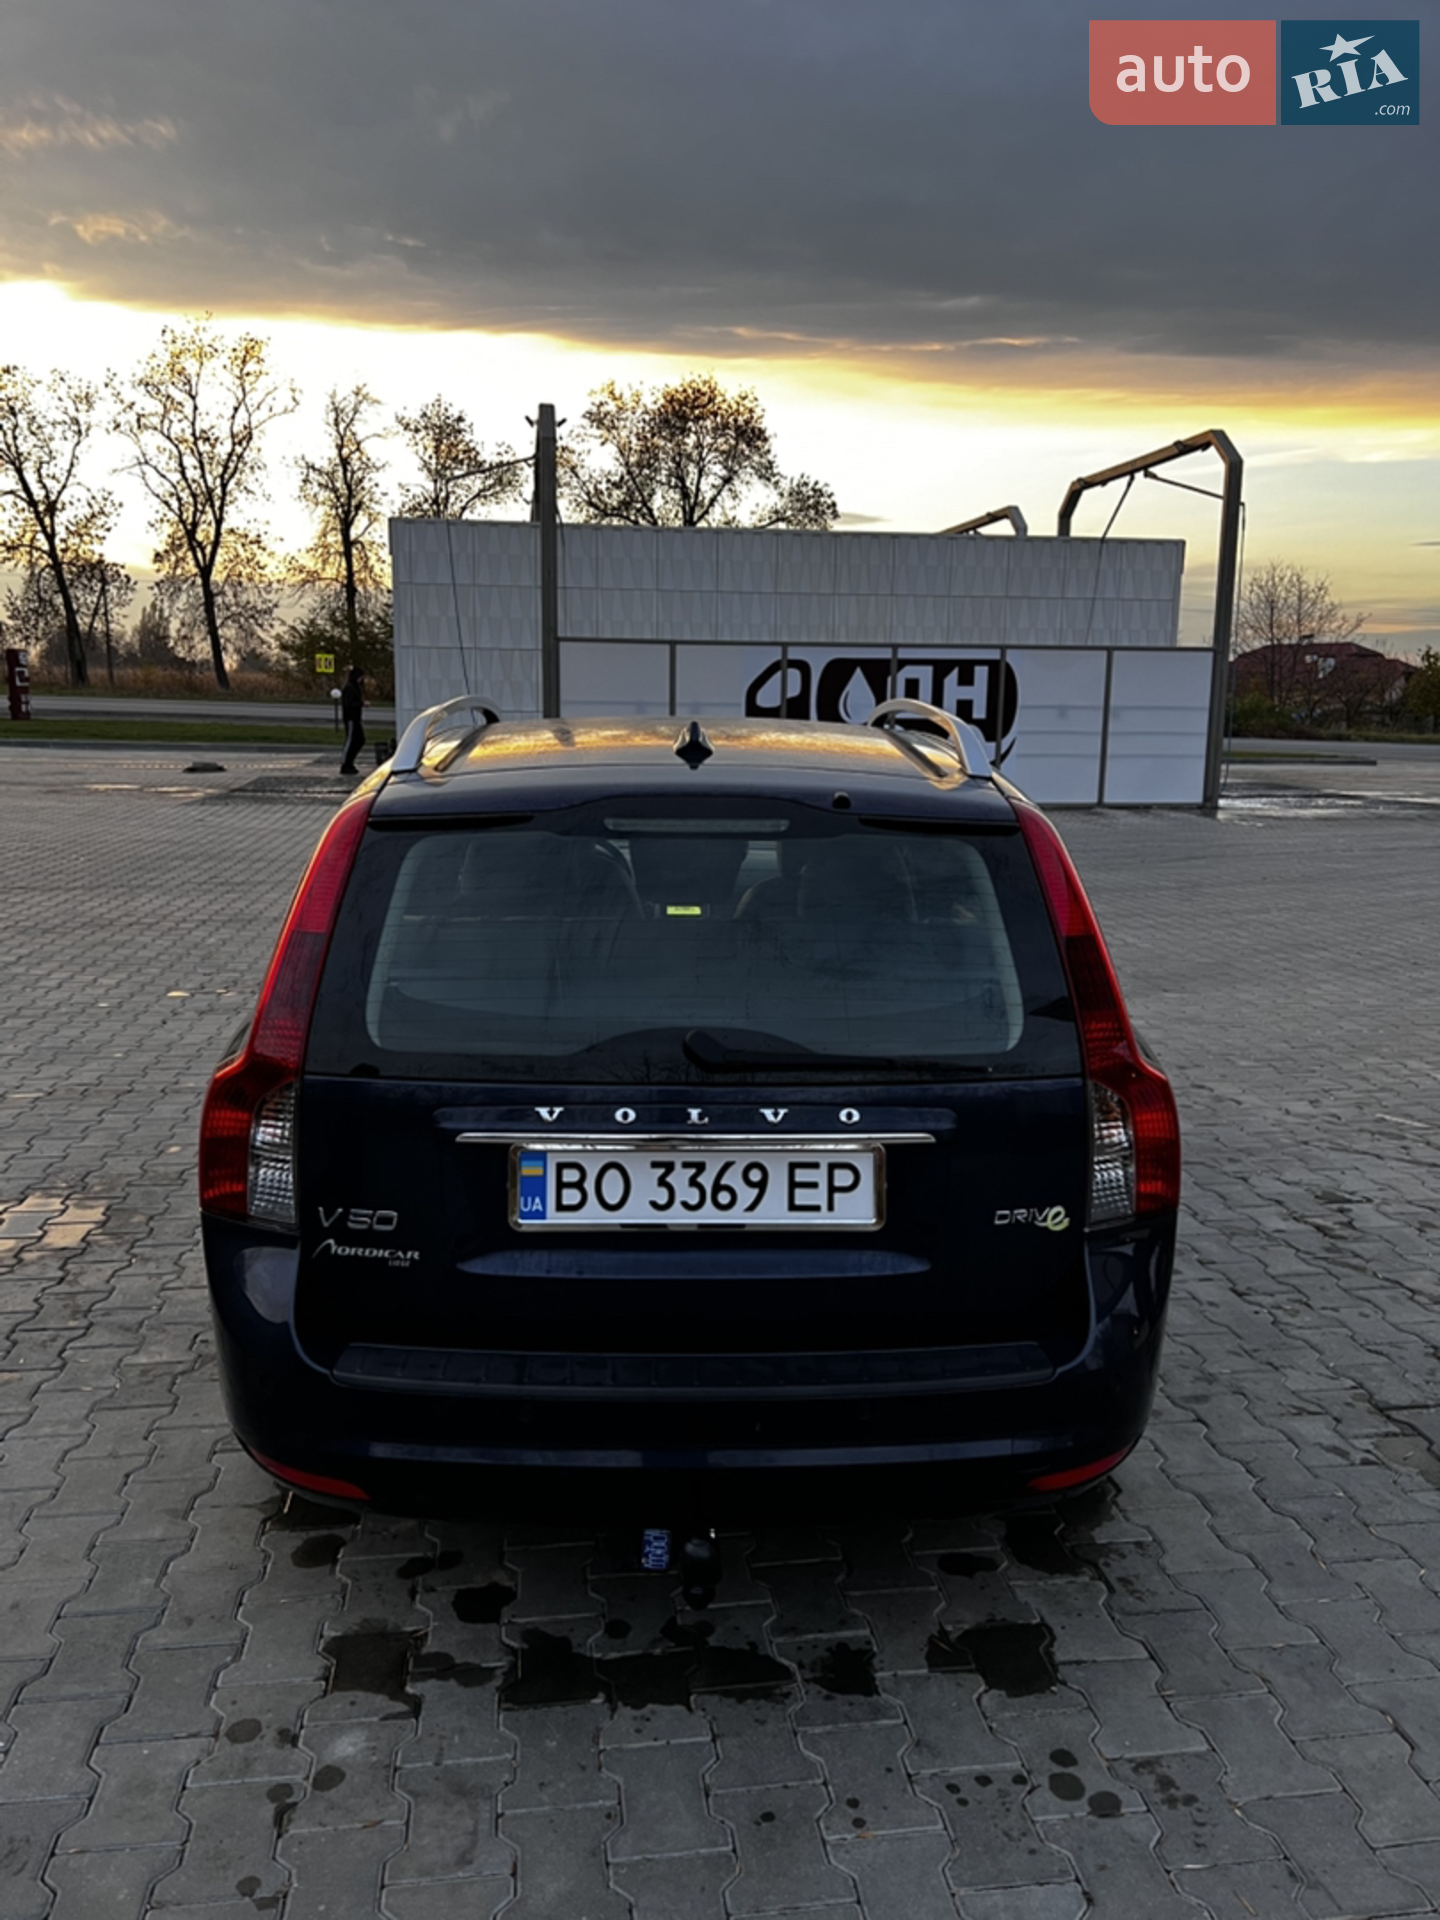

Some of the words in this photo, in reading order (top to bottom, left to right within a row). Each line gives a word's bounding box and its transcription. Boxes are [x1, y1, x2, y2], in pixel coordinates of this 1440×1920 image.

[535, 1107, 861, 1124] VOLVO
[554, 1161, 631, 1213] BO
[648, 1161, 769, 1213] 3369
[787, 1161, 861, 1213] EP
[520, 1197, 543, 1212] UA
[317, 1206, 398, 1231] V50
